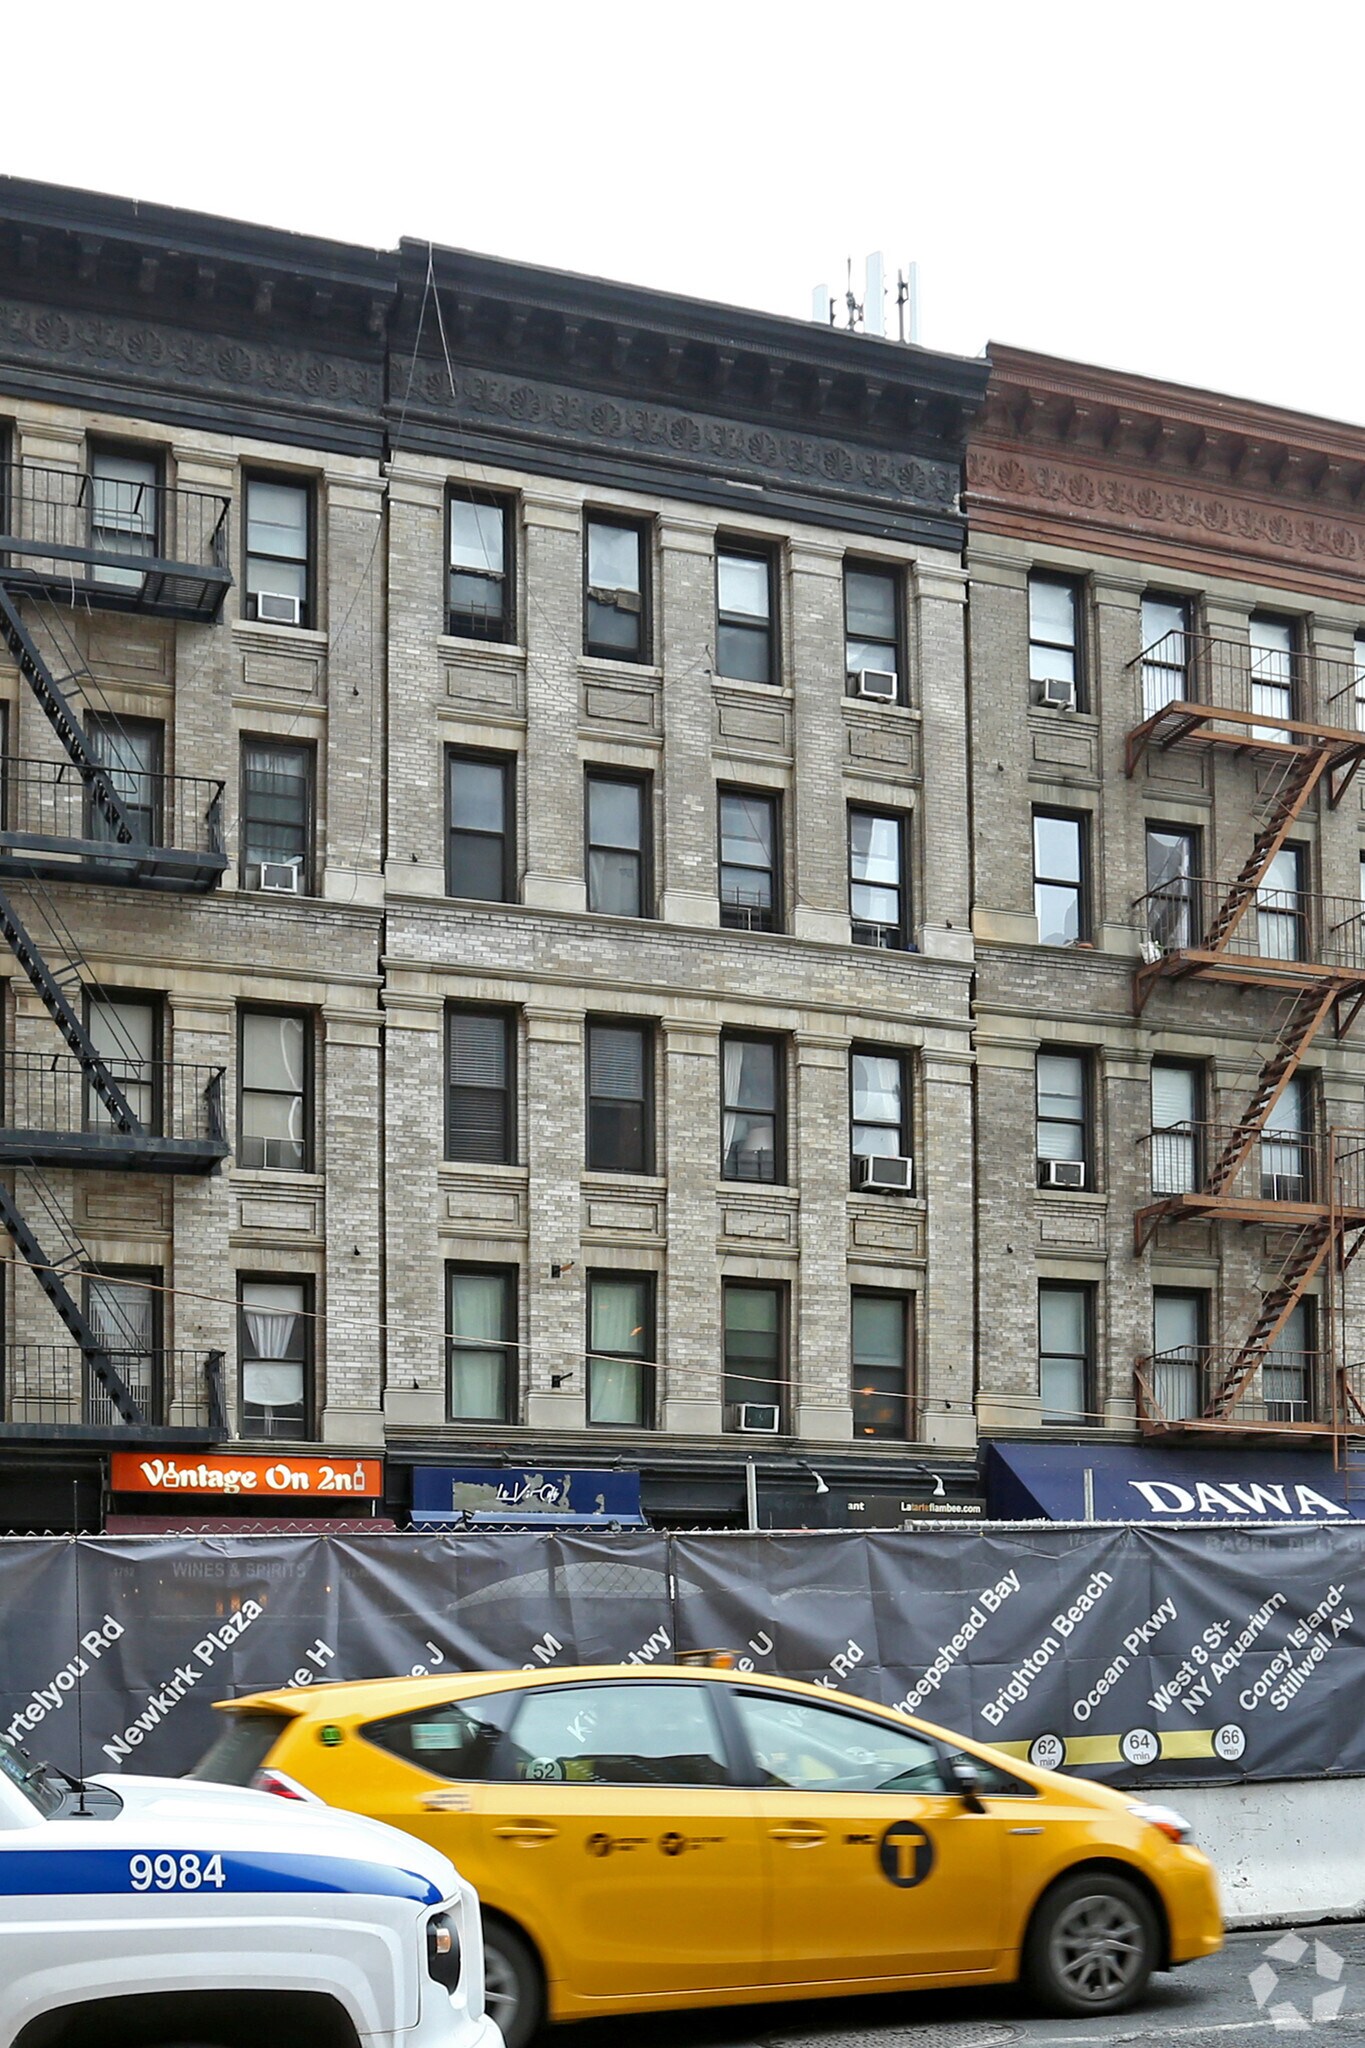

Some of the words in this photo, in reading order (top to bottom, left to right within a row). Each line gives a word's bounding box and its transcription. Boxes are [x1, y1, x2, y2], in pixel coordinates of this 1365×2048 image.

[265, 1464, 309, 1490] On
[1127, 1480, 1350, 1515] DAWA
[171, 1561, 226, 1579] WINES
[246, 1561, 307, 1579] SPIRITS
[80, 1614, 125, 1659] Rd
[532, 1632, 563, 1664] M
[748, 1630, 774, 1656] U
[893, 1606, 988, 1716] heepshead
[979, 1568, 1021, 1613] Bay
[980, 1635, 1060, 1727] Brighton
[1051, 1569, 1113, 1638] Beach
[1238, 1647, 1294, 1711] Coney
[1286, 1583, 1346, 1650] Island-
[306, 1638, 335, 1668] H
[426, 1641, 444, 1665] J
[829, 1639, 865, 1679] Rd
[1072, 1654, 1130, 1722] Ocean
[1122, 1597, 1178, 1657] Pkwy
[1180, 1676, 1213, 1716] NY
[1209, 1591, 1287, 1684] Aquarium
[1270, 1632, 1332, 1712] Stillwell
[1330, 1606, 1356, 1639] Av
[102, 1663, 203, 1765] Newkirk
[192, 1598, 263, 1667] Plaza
[1147, 1660, 1199, 1715] West
[1191, 1644, 1209, 1665] 8
[1037, 1739, 1057, 1755] 62
[1128, 1734, 1151, 1750] 64
[1220, 1729, 1240, 1745] 66
[1222, 1746, 1240, 1757] min
[532, 1762, 556, 1780] 52
[1039, 1757, 1056, 1767] min
[1132, 1751, 1151, 1761] min
[129, 1853, 226, 1891] 9984
